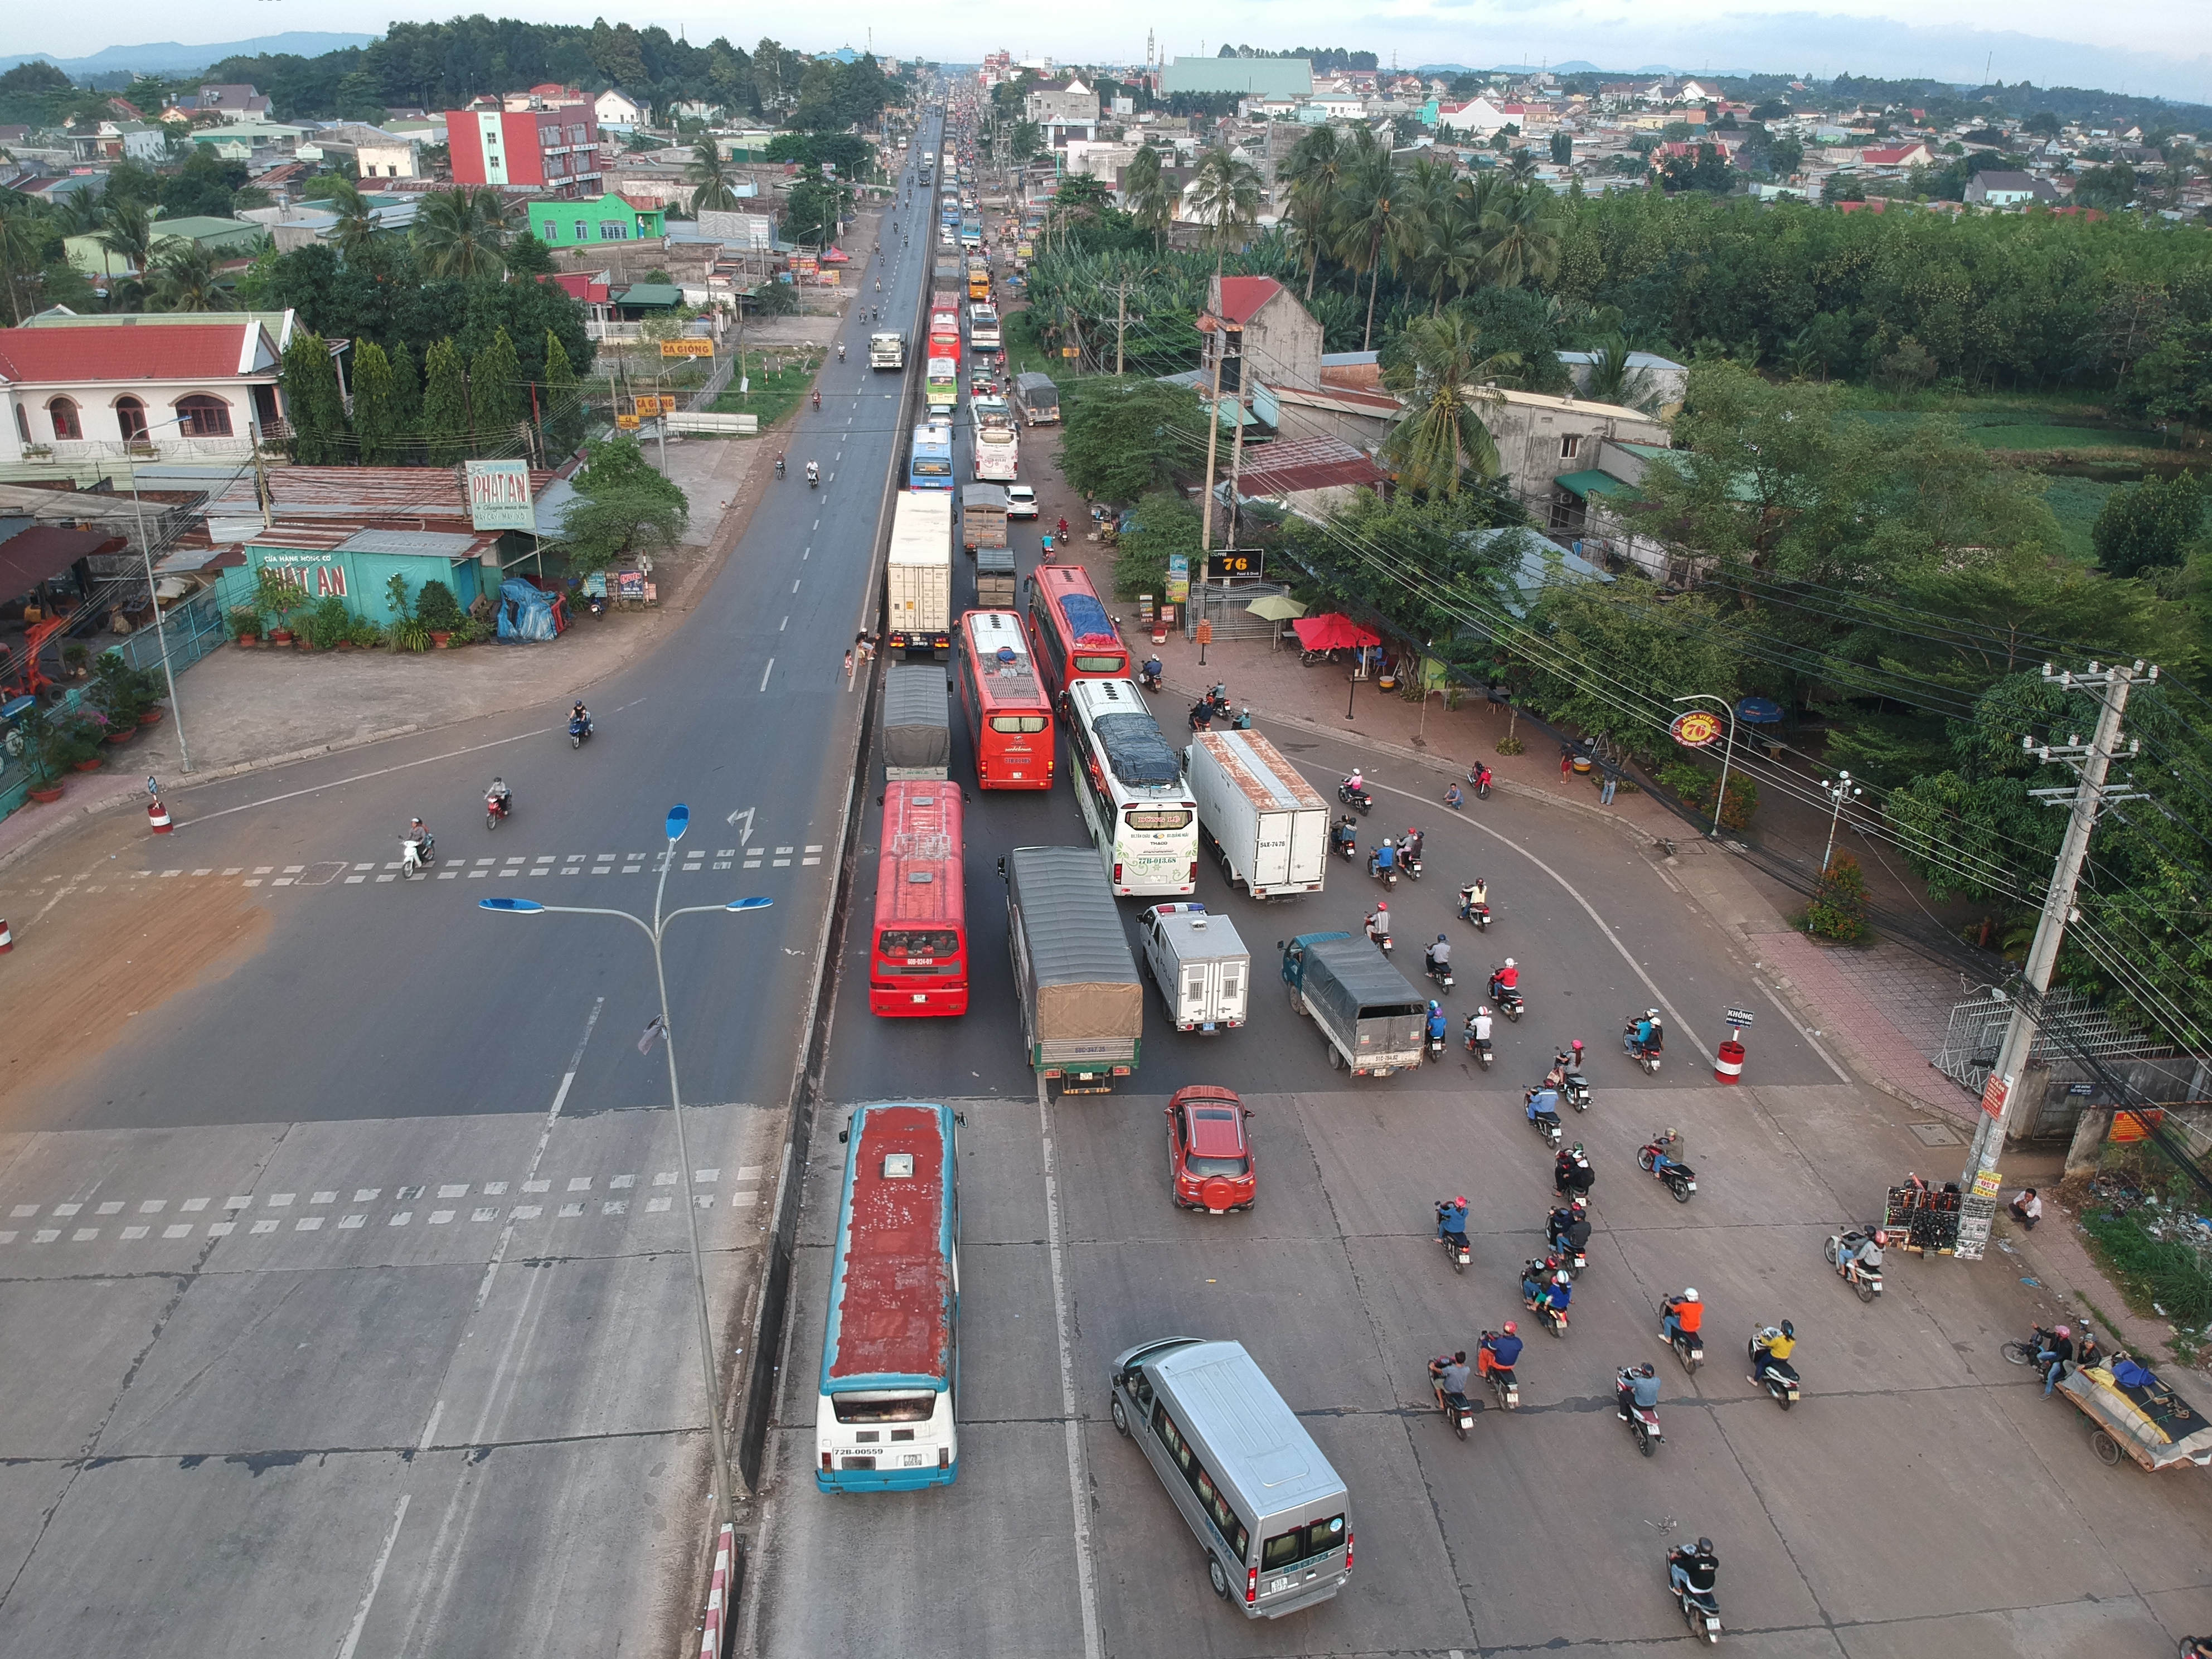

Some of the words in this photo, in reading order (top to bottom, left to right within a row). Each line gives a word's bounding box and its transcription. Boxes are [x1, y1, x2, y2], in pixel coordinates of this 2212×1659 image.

[473, 472, 506, 503] PHÁT
[508, 473, 527, 502] AN
[1223, 558, 1247, 570] 76
[1686, 724, 1707, 738] 76
[1728, 1010, 1753, 1021] KHÔNG
